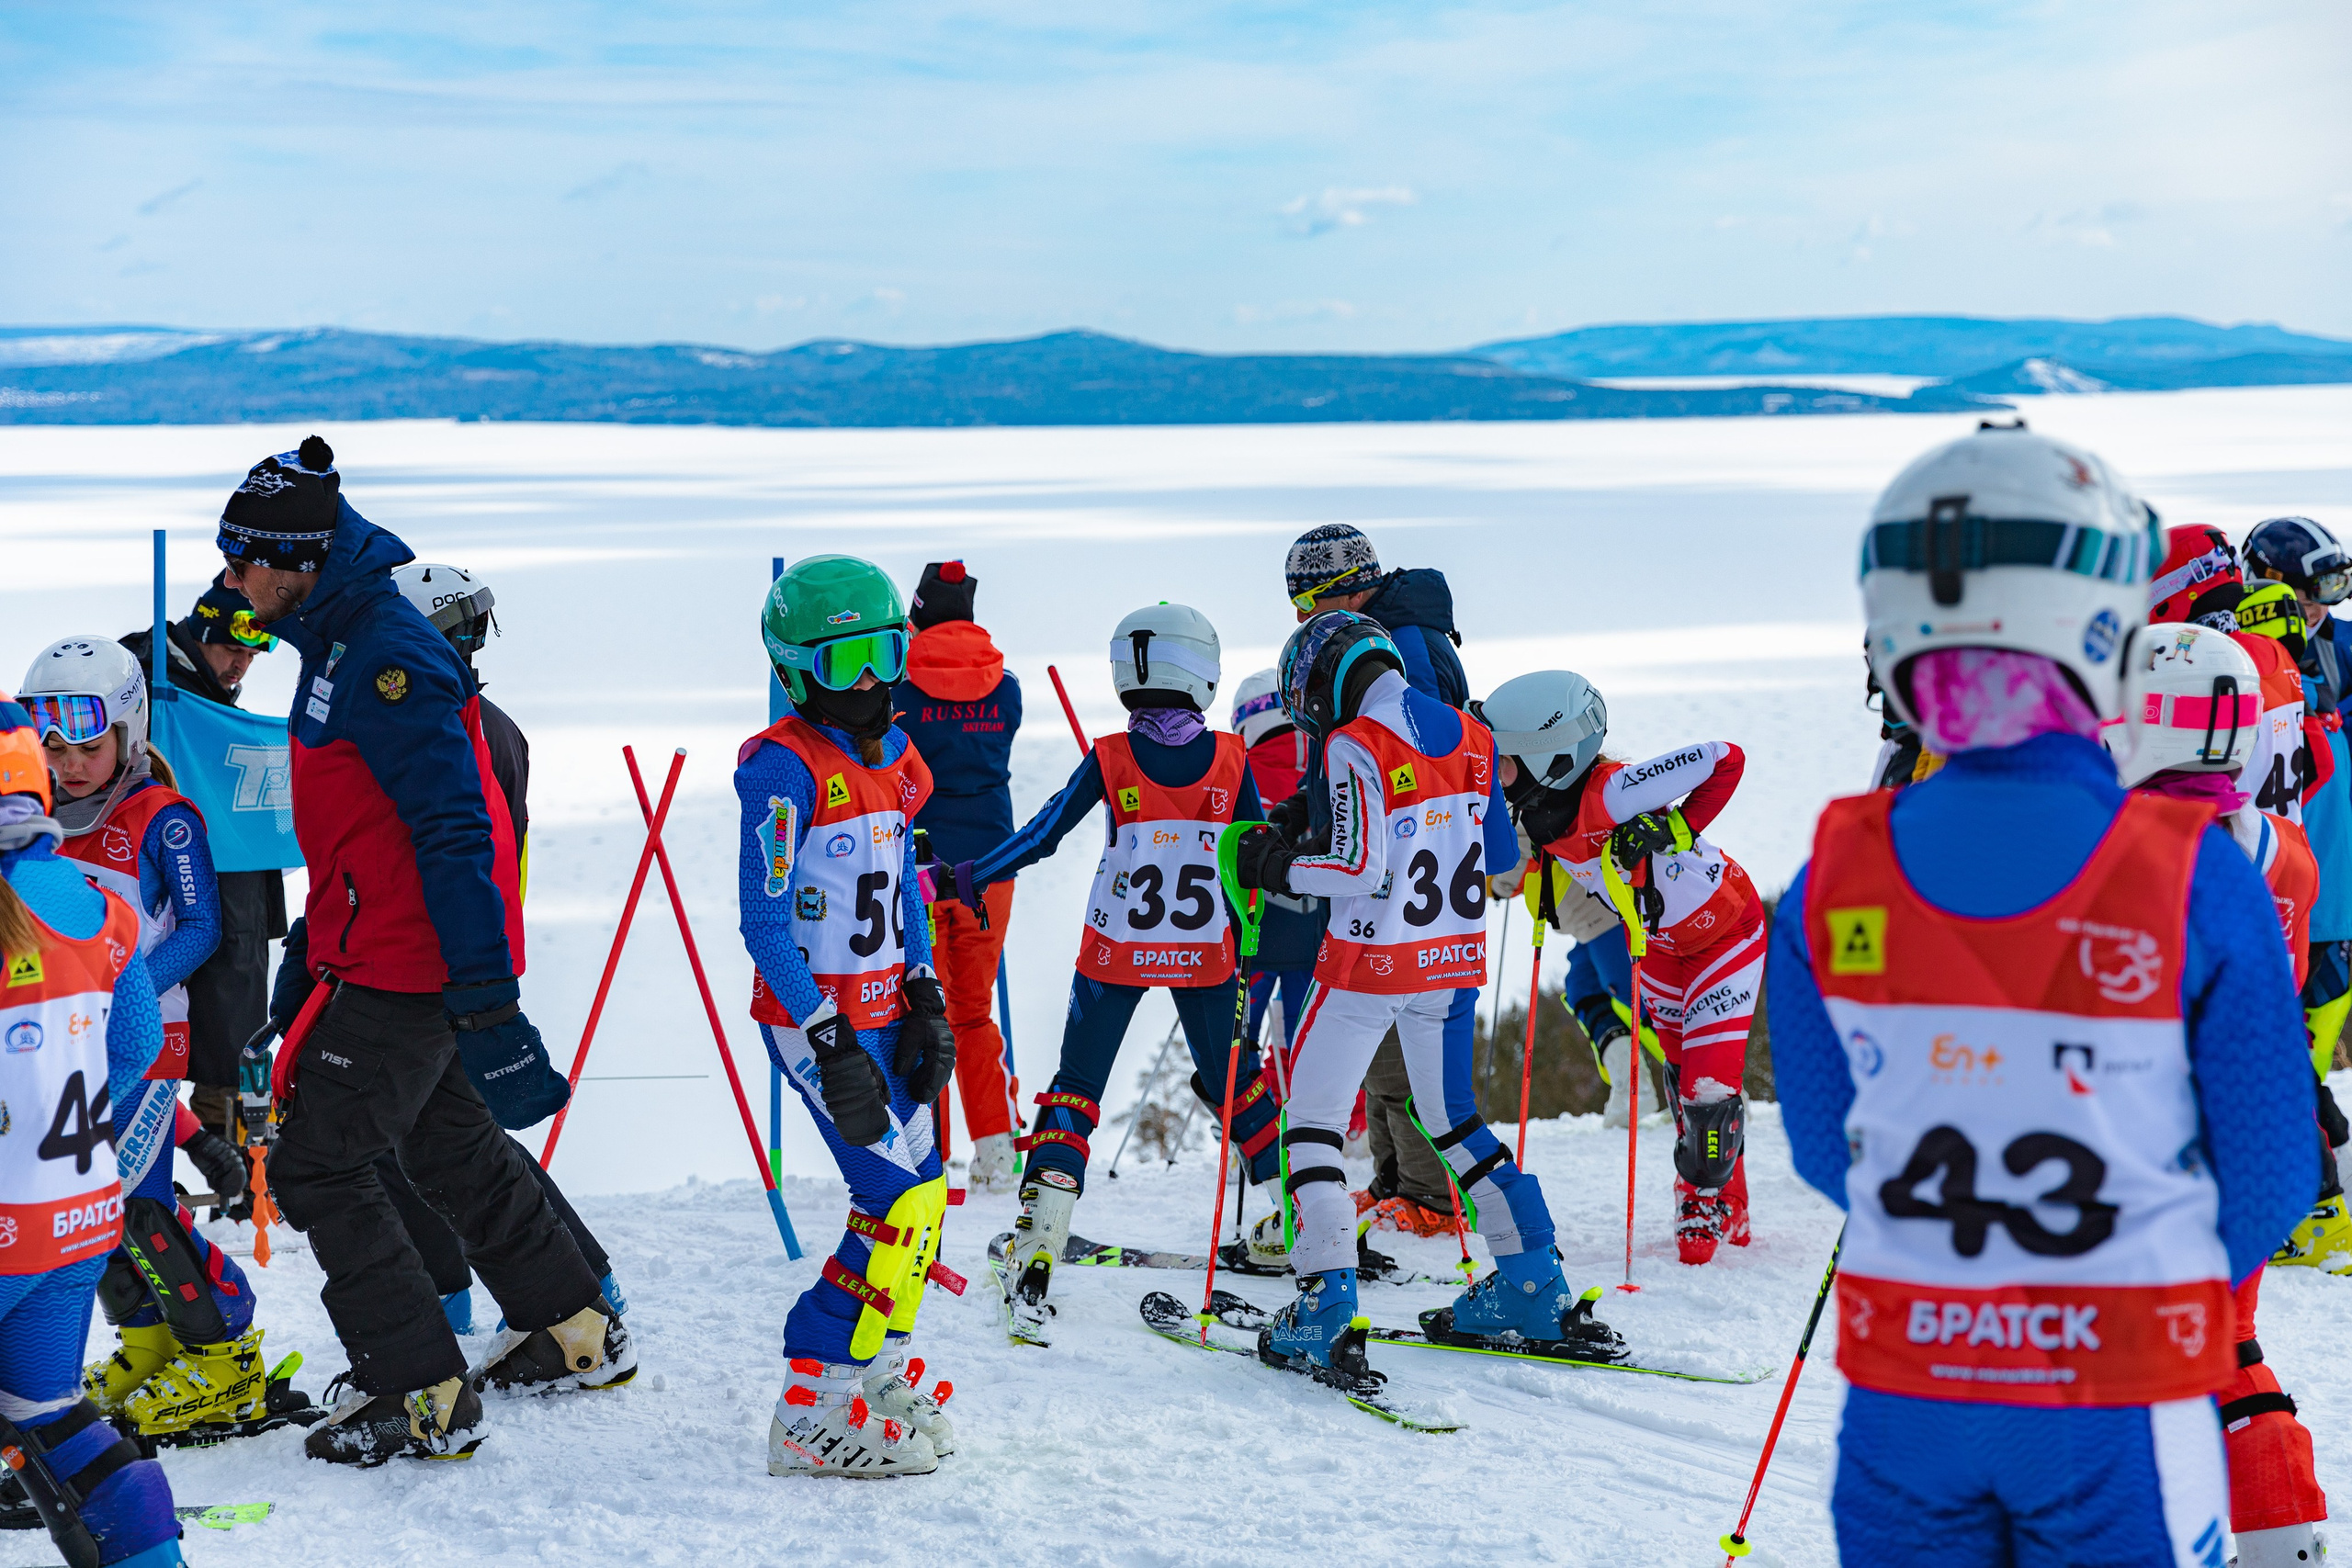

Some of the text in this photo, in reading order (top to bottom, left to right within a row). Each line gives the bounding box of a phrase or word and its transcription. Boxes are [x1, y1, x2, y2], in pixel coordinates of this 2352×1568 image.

[921, 704, 1000, 724] RUSSIA
[1518, 736, 1563, 748] ATOMIC
[1637, 814, 1660, 832] LEKI
[768, 807, 790, 894] Вершина
[176, 854, 197, 906] RUSSIA
[1403, 840, 1486, 927] 36
[1128, 863, 1216, 931] 35
[1091, 908, 1109, 929] 35
[1349, 919, 1375, 939] 36
[1133, 950, 1203, 967] БРАТСК
[1417, 942, 1486, 969] БРАТСК
[1236, 976, 1246, 1021] LEKI
[1684, 985, 1732, 1025] RACING
[1711, 990, 1752, 1017] TEAM
[484, 1053, 537, 1081] EXTREME
[1051, 1094, 1089, 1109] LEKI
[1245, 1081, 1265, 1103] LEKI
[118, 1077, 177, 1179] VERSHINA
[1032, 1132, 1066, 1145] LEKI
[1708, 1130, 1719, 1159] LEKI
[1040, 1173, 1078, 1188] HEAD
[1879, 1125, 2120, 1258] 43
[52, 1192, 125, 1239] БРАТСК
[847, 1213, 878, 1235] LEKI
[129, 1246, 172, 1297] LEKI
[837, 1273, 877, 1303] LEKI
[1907, 1299, 2100, 1351] БРАТСК
[153, 1371, 262, 1422] FISCHER
